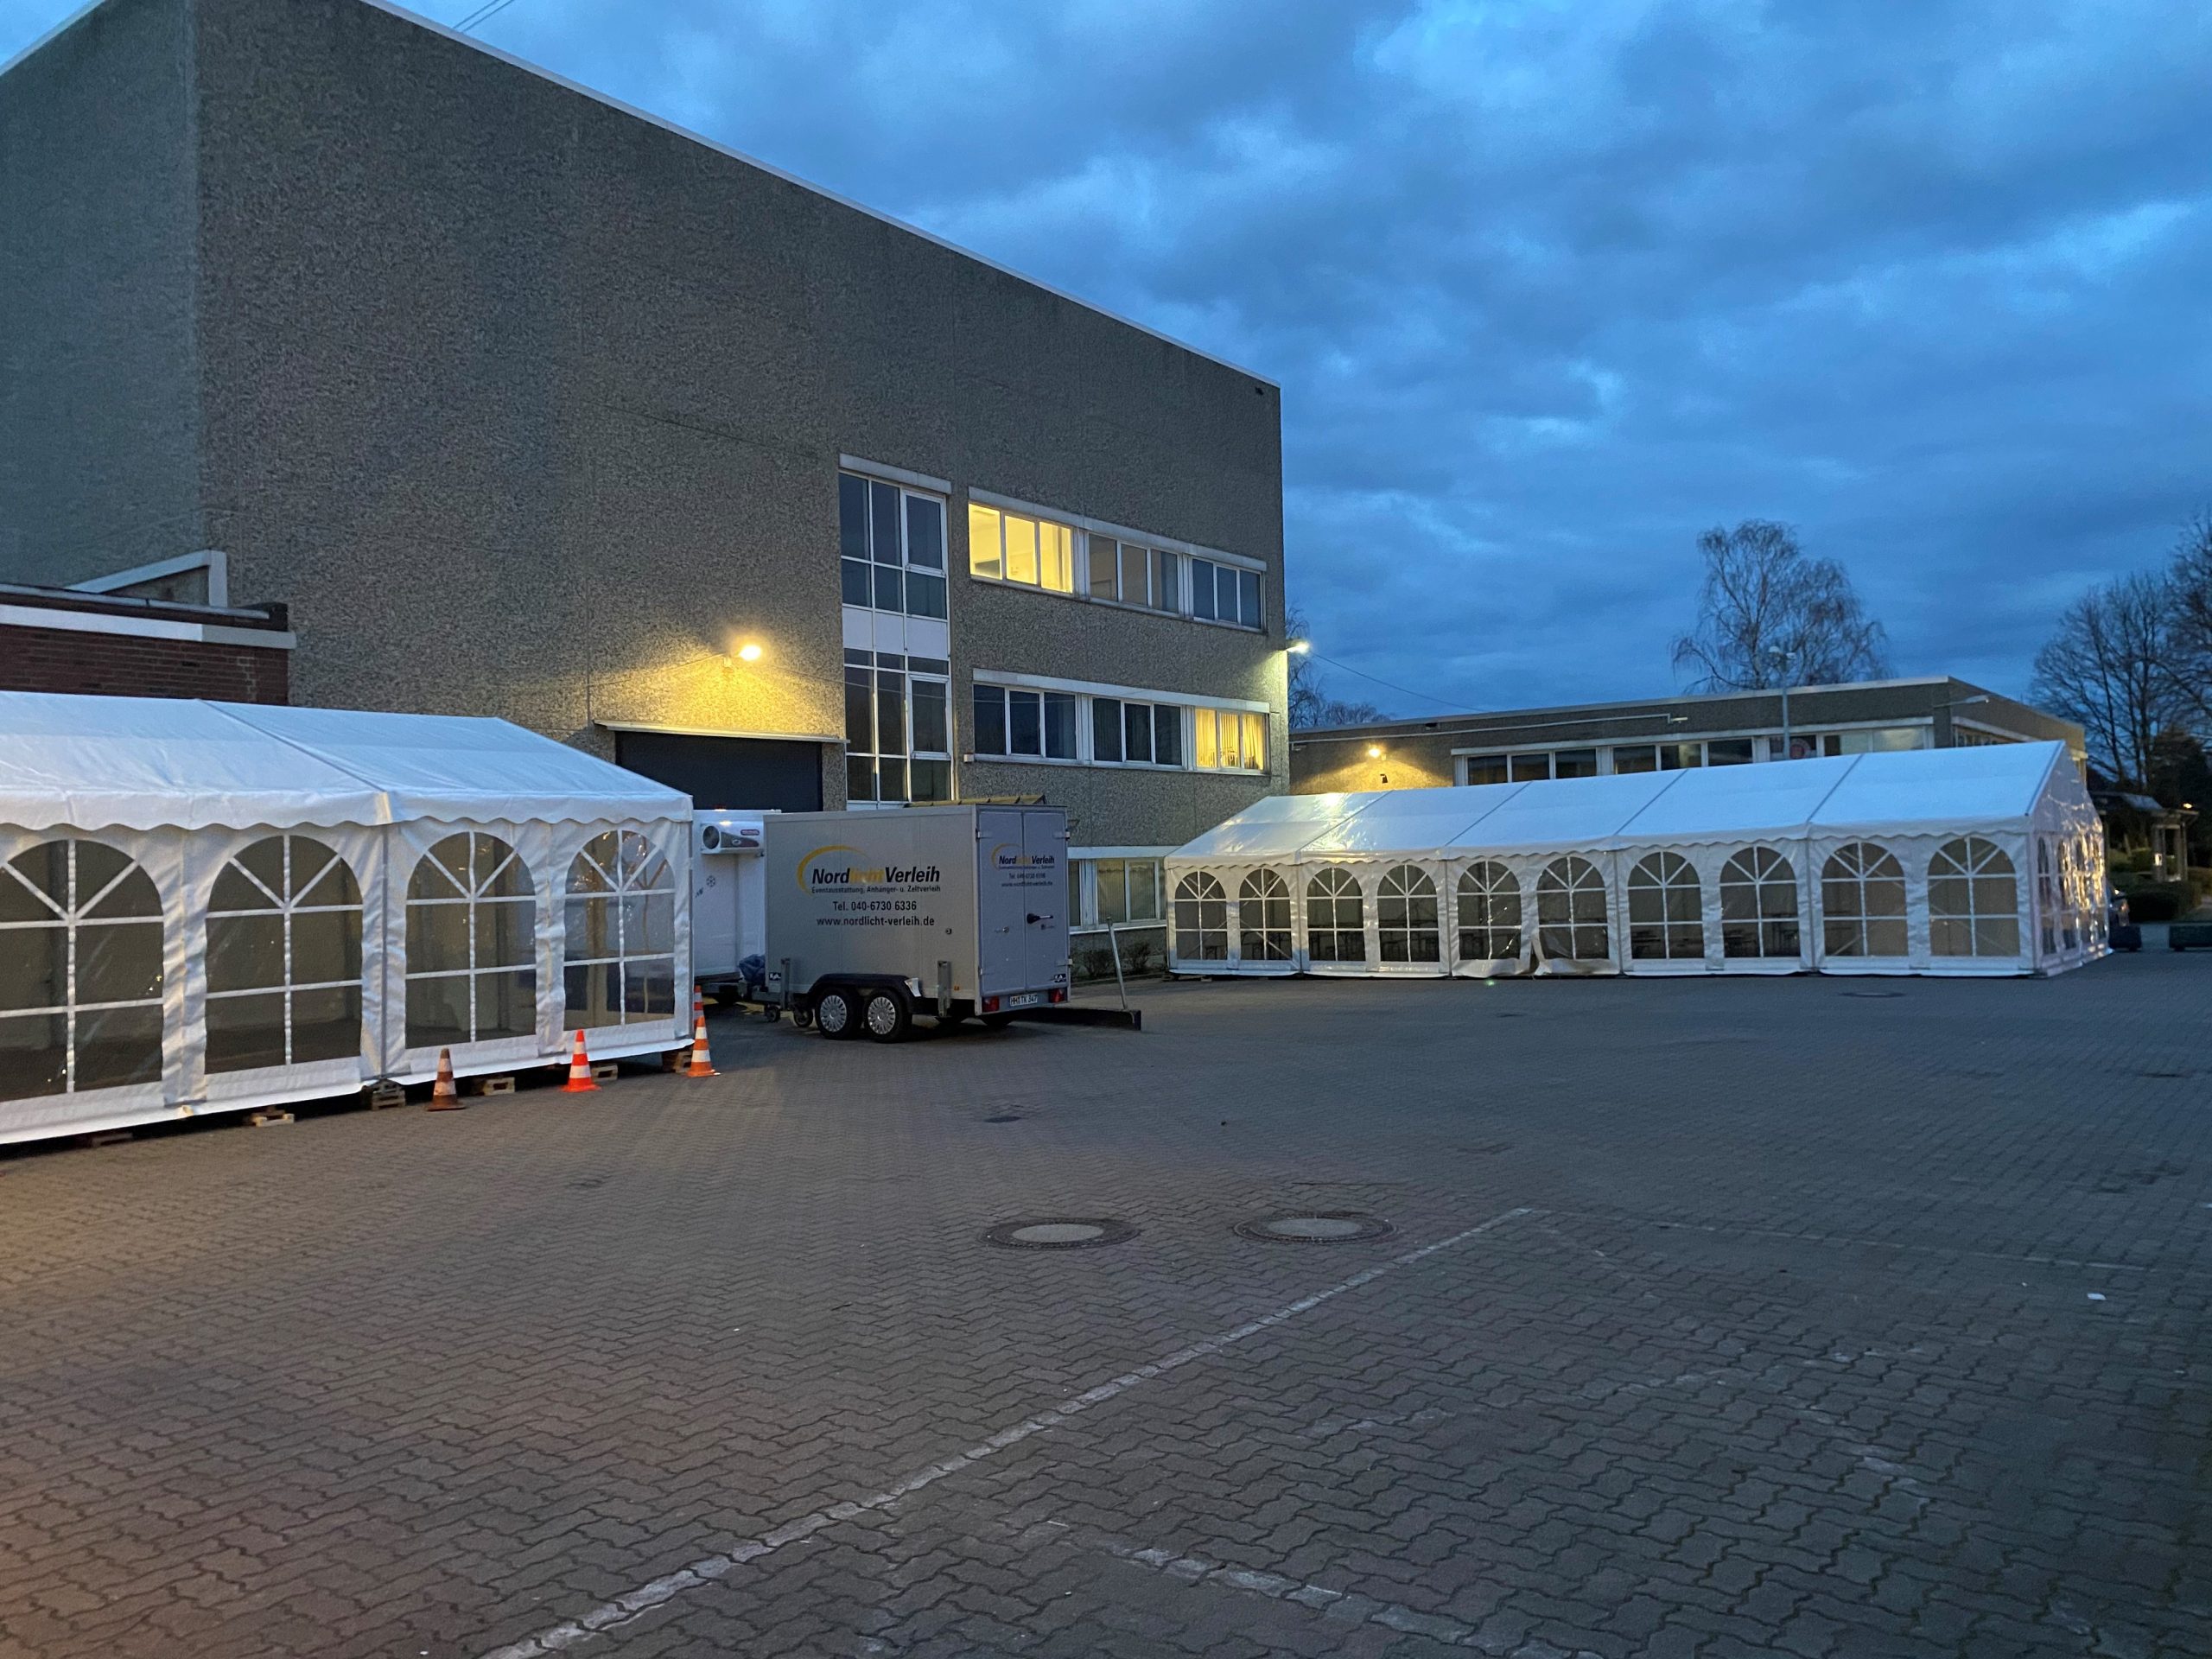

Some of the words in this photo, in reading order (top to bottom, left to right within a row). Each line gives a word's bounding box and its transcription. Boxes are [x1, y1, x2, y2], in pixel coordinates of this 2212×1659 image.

[885, 866, 940, 883] Verleih
[832, 901, 849, 911] Tel.
[851, 901, 892, 911] 040-6730
[894, 900, 918, 911] 6336
[817, 916, 935, 925] www.nordlicht-verleih.de
